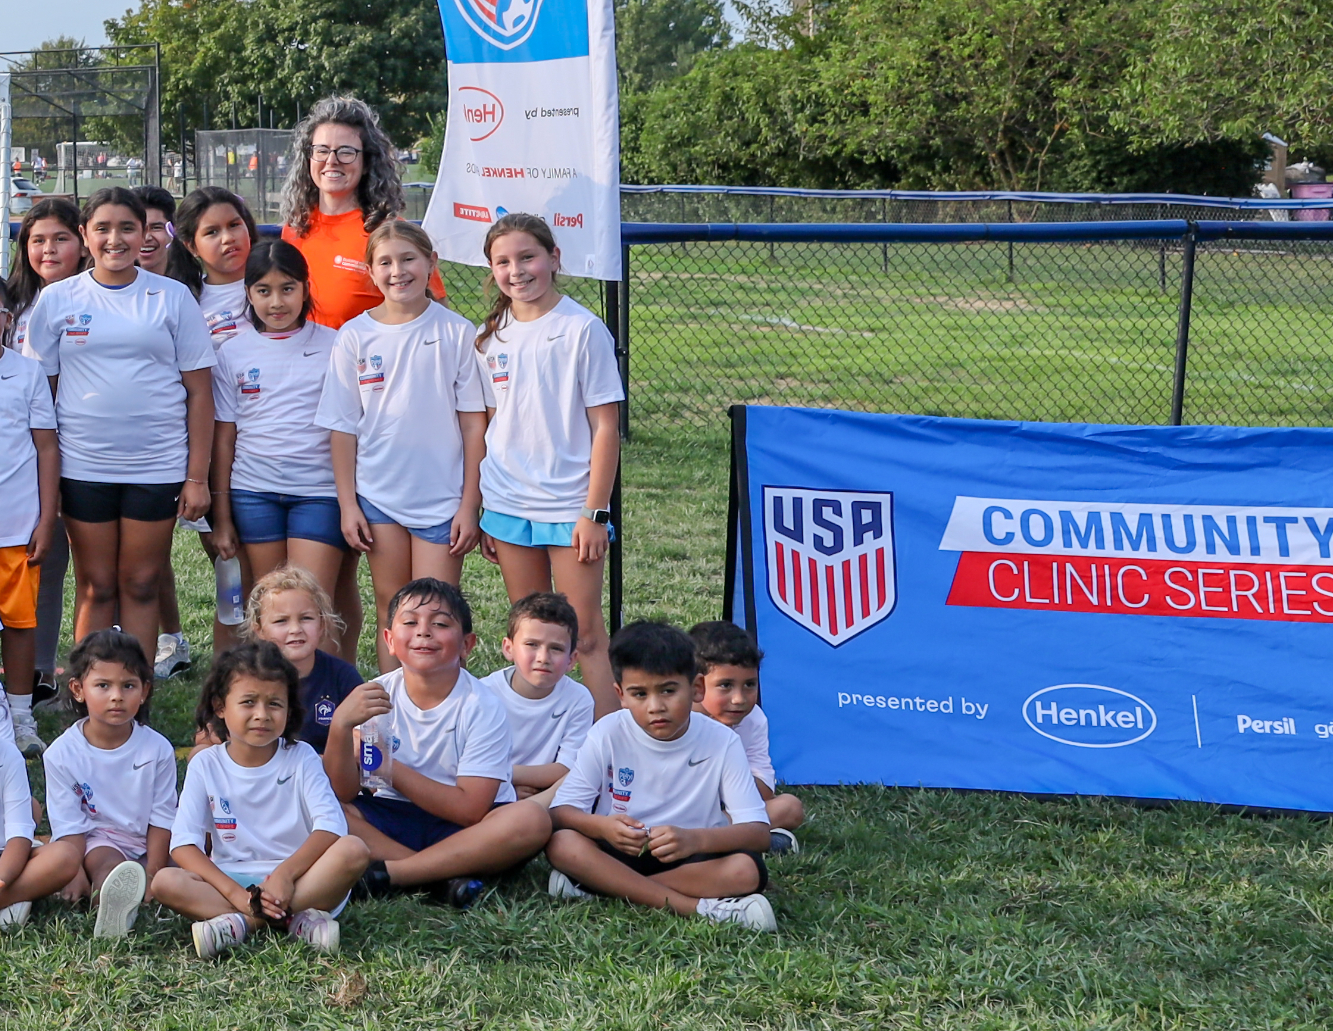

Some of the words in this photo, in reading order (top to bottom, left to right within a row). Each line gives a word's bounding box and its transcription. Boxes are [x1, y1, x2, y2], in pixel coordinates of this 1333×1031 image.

[773, 495, 883, 556] USA
[982, 505, 1333, 558] COMMUNITY
[988, 559, 1150, 608] CLINIC
[1164, 566, 1333, 617] SERIES
[837, 691, 953, 714] presented
[961, 697, 989, 720] by
[1035, 700, 1144, 729] Henkel
[1237, 714, 1296, 735] Persil
